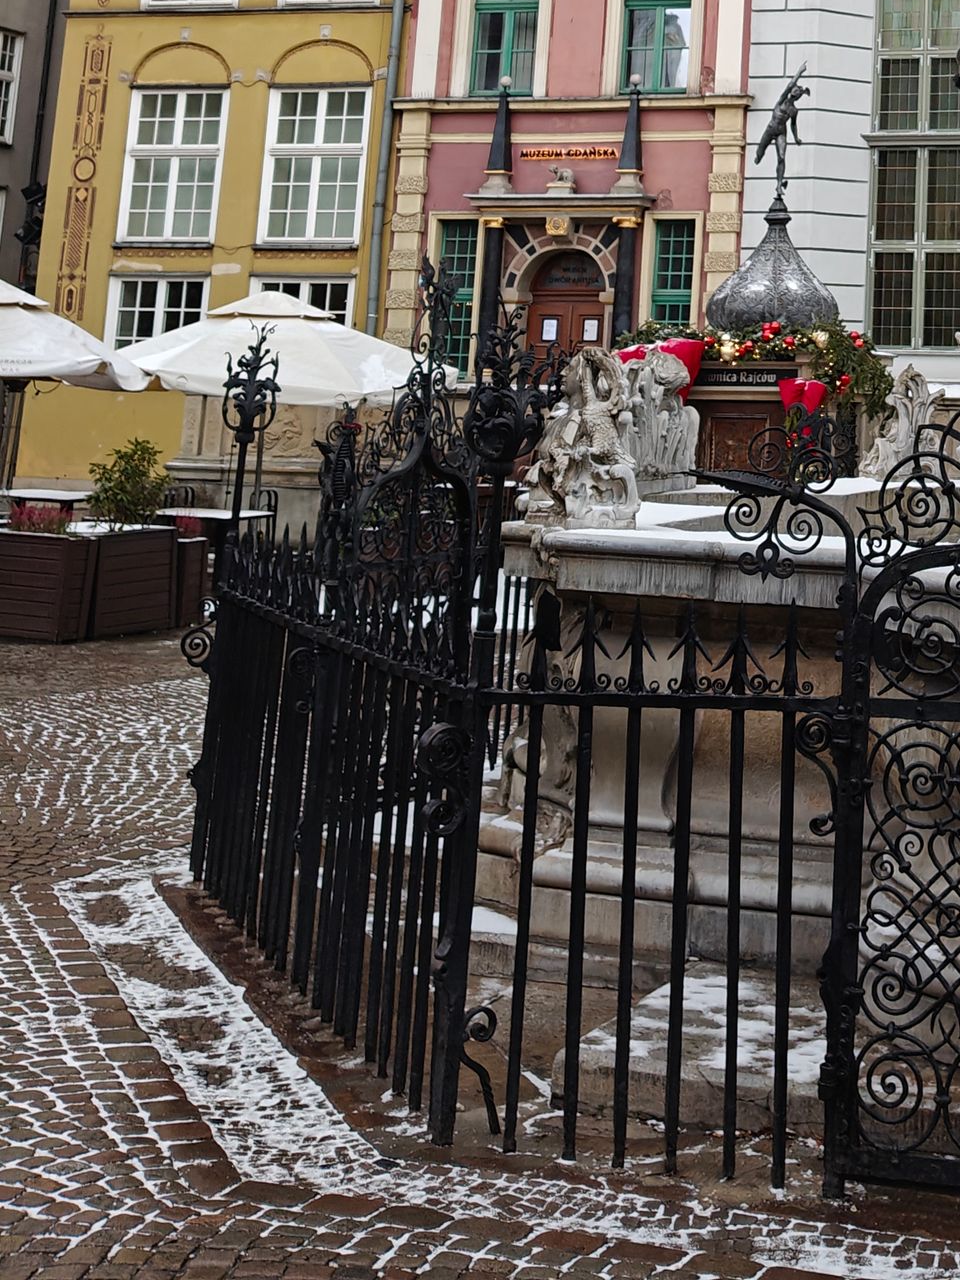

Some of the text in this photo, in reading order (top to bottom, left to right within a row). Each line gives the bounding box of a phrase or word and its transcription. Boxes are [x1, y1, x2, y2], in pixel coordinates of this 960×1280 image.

[520, 146, 617, 159] MUZEUM GDAŃSKA
[704, 371, 776, 384] wnica Rajców
